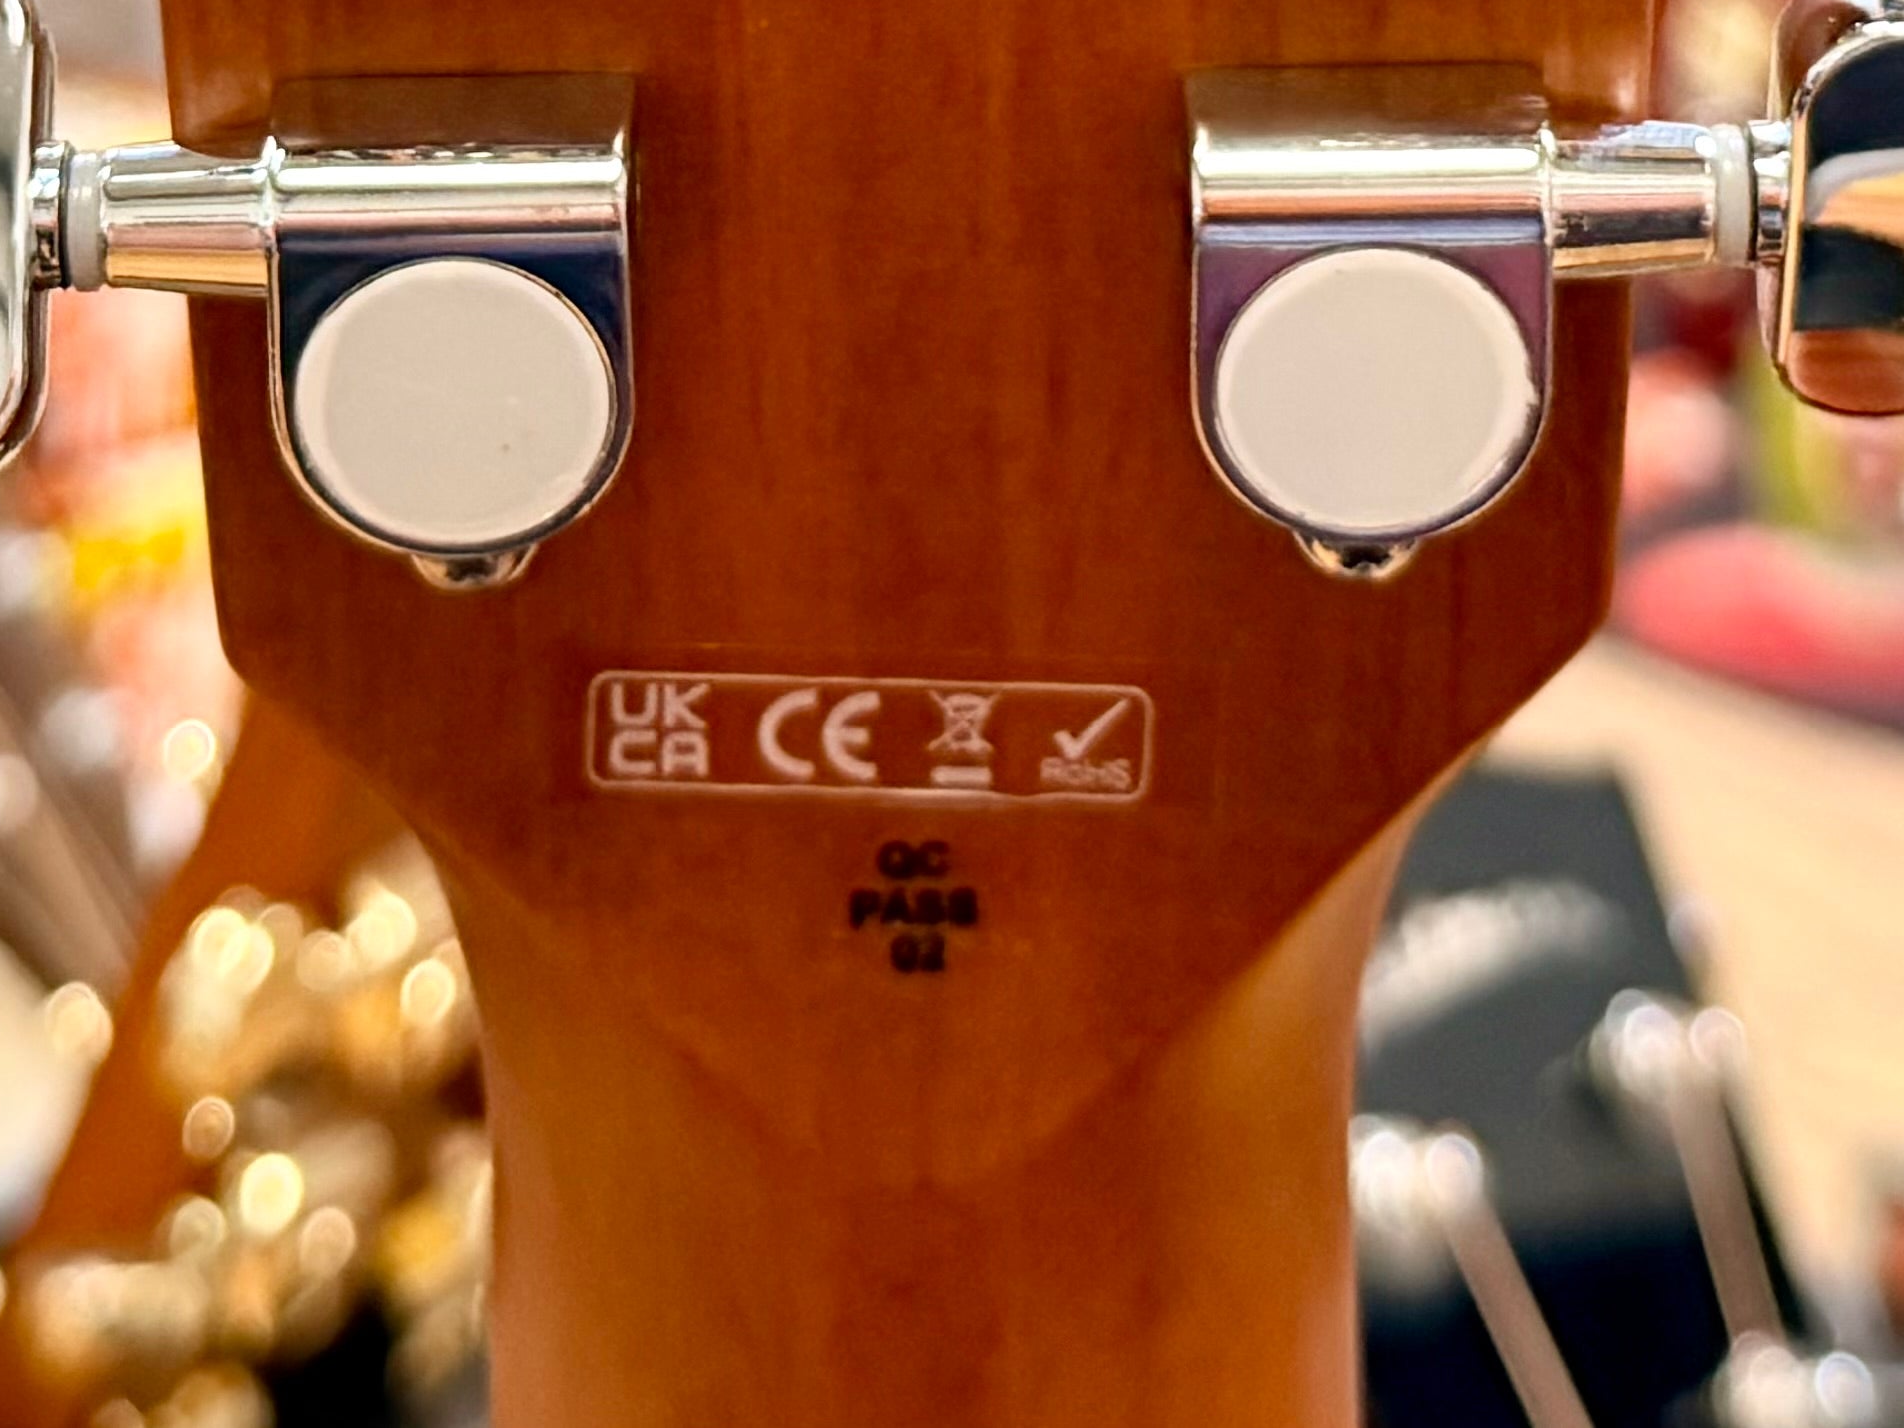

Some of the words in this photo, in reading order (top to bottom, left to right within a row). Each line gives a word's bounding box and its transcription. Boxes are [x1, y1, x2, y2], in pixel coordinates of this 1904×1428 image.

[610, 682, 709, 729] UK
[609, 730, 709, 776] CA
[757, 689, 881, 781] CE
[876, 840, 950, 879] QC
[849, 887, 979, 930] PASS
